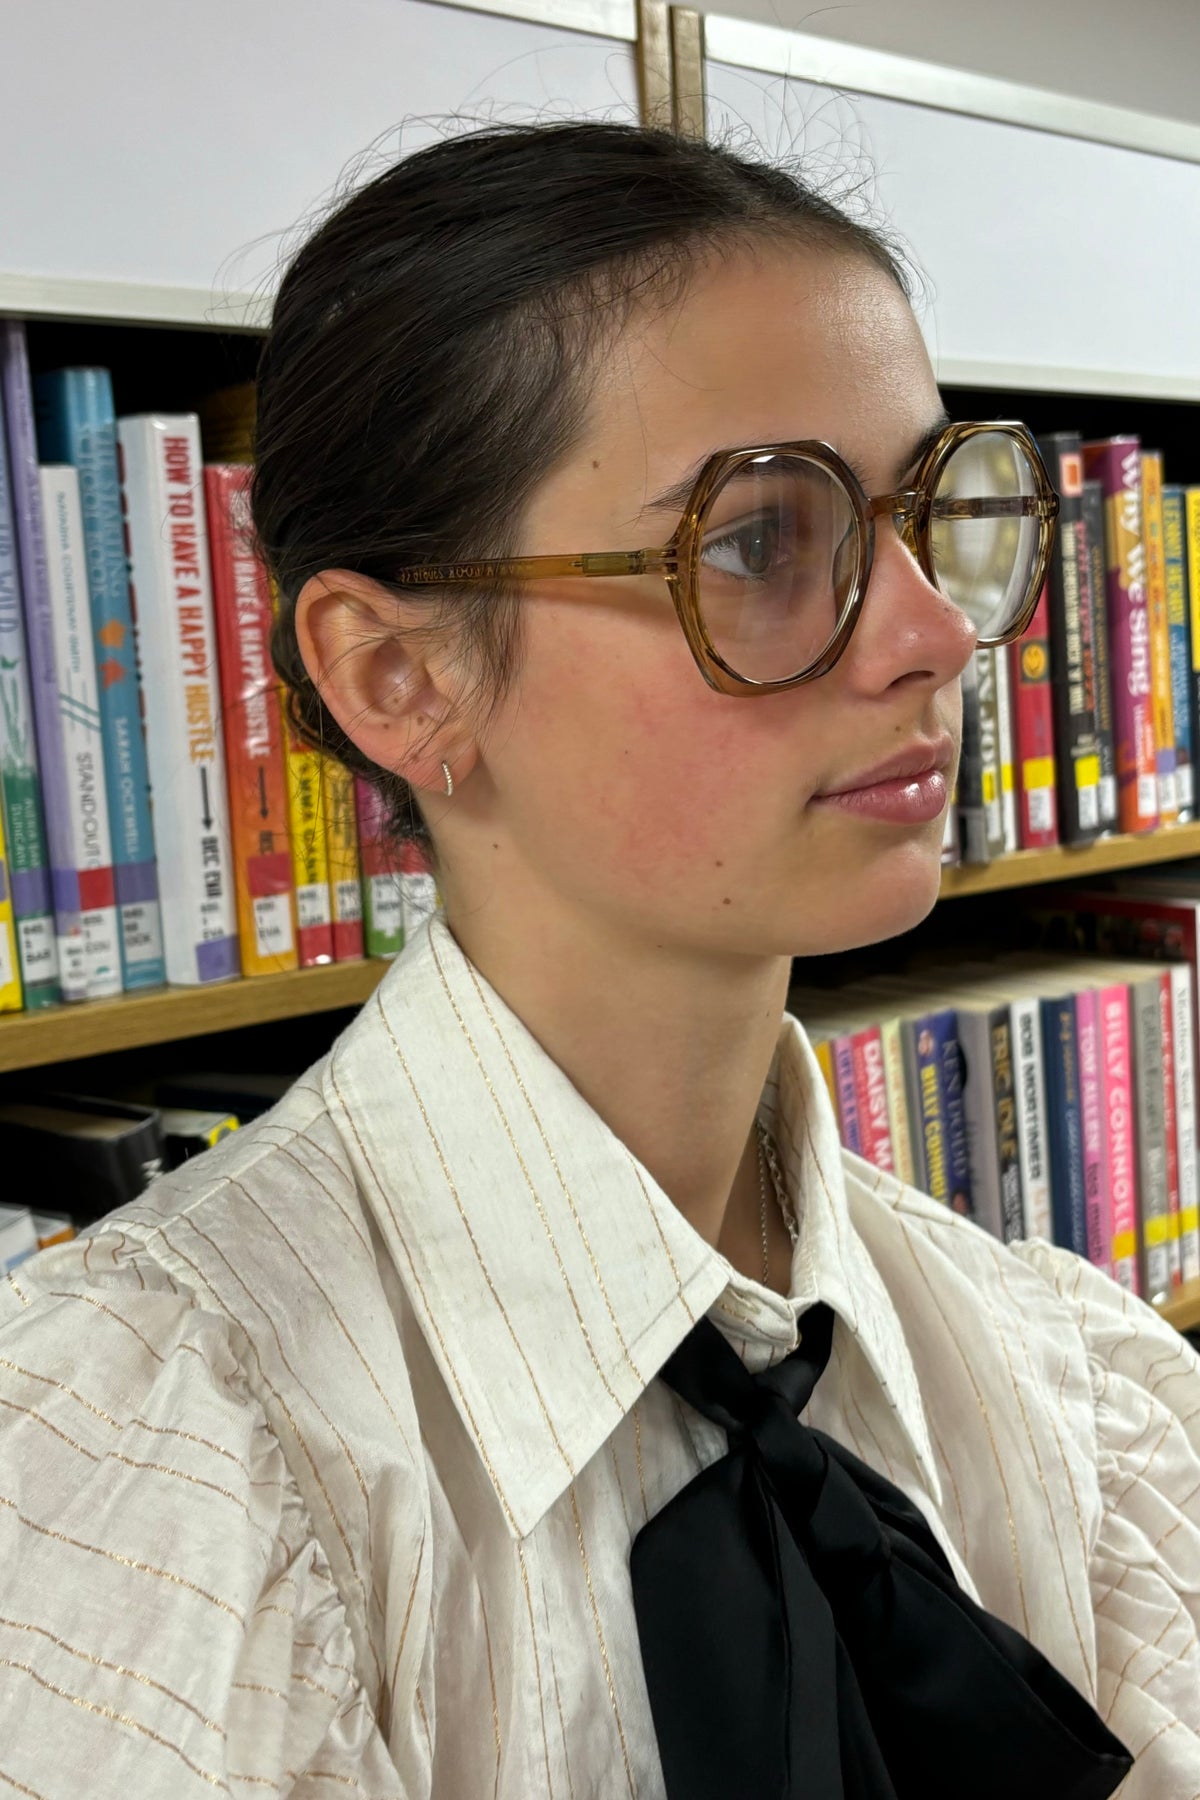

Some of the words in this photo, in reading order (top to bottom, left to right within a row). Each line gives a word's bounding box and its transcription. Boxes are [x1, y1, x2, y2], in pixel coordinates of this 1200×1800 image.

[163, 437, 191, 486] HOW
[1119, 449, 1140, 535] Why
[169, 494, 195, 518] TO
[170, 524, 201, 579] HAVE
[235, 560, 261, 608] HAVE
[1127, 542, 1146, 603] We
[176, 585, 203, 600] A
[239, 611, 261, 625] A
[177, 606, 208, 678] HAPPY
[1127, 608, 1151, 696] Sing
[184, 684, 215, 765] HUSTLE
[942, 1039, 961, 1092] KEN
[992, 1024, 1010, 1091] ERIC
[1021, 1013, 1036, 1057] BOB
[1106, 1001, 1126, 1079] BILLY
[864, 1039, 888, 1128] DAISY
[921, 1064, 939, 1118] BILLY
[1084, 1080, 1100, 1153] ALLEN
[997, 1096, 1018, 1161] IDLE
[1023, 1062, 1043, 1180] MORTIMER
[925, 1120, 948, 1202] CONNOL
[1110, 1087, 1133, 1233] CONNOLL
